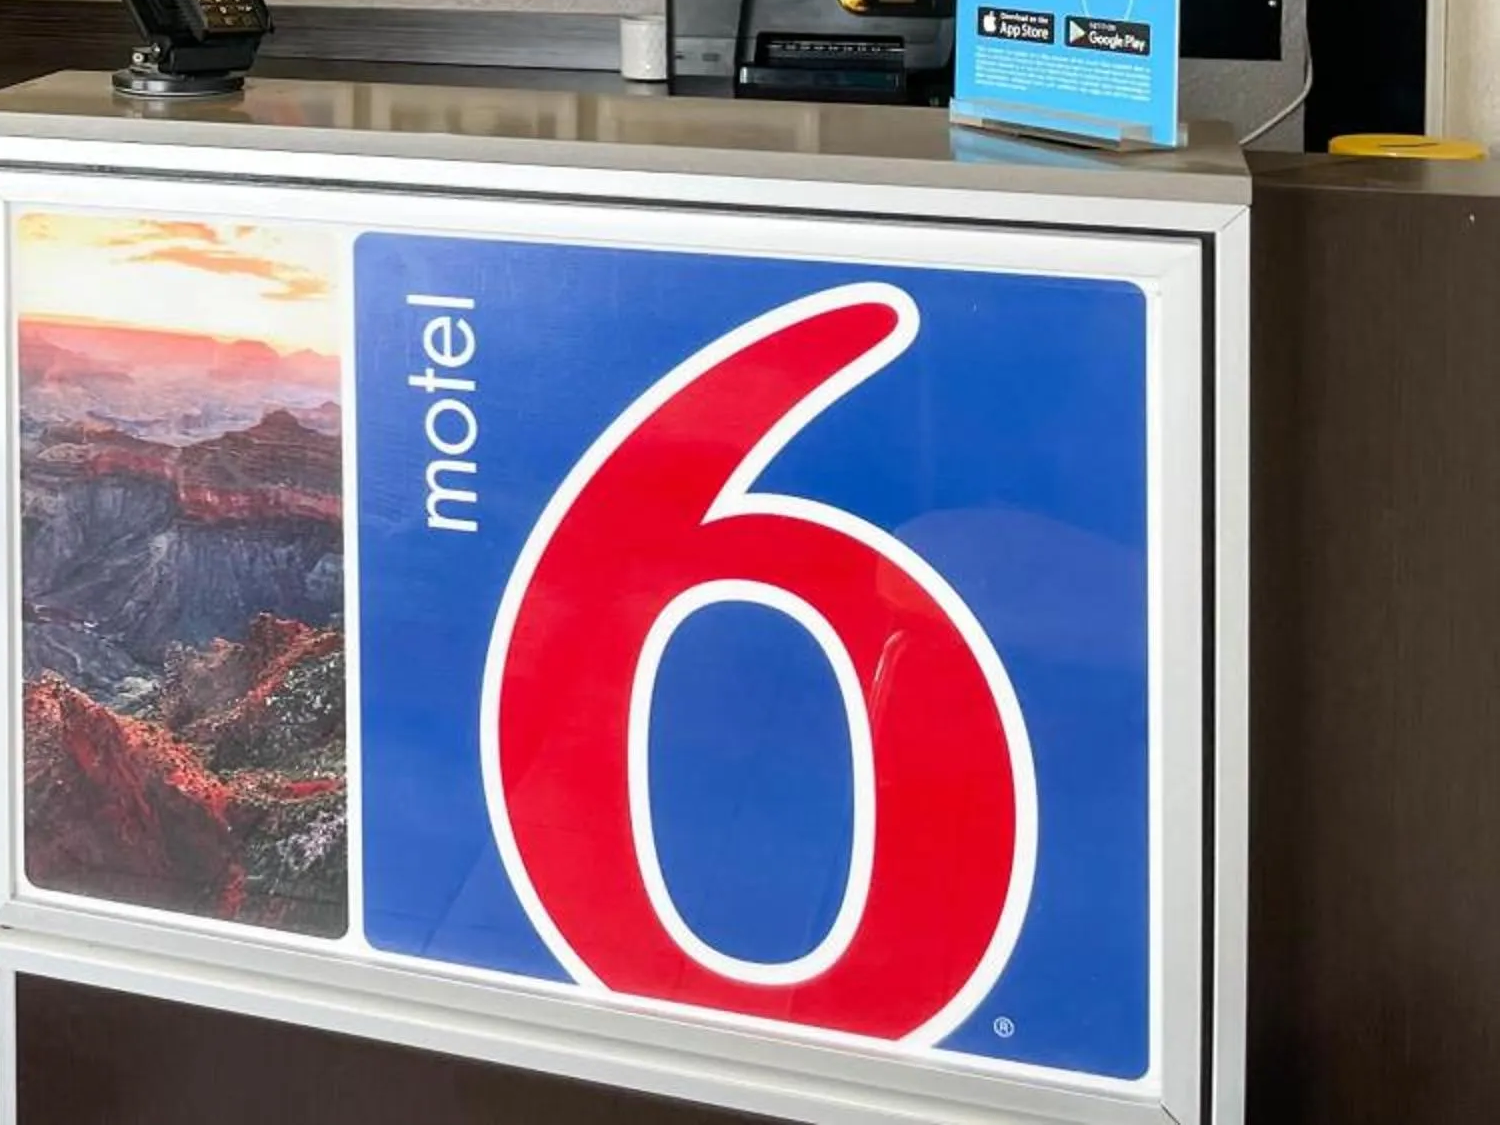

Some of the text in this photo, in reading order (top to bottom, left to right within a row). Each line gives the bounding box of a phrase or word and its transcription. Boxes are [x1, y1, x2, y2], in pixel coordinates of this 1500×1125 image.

[1000, 21, 1049, 40] App Store
[1088, 30, 1146, 52] Google Play
[406, 282, 1039, 1048] motel 6
